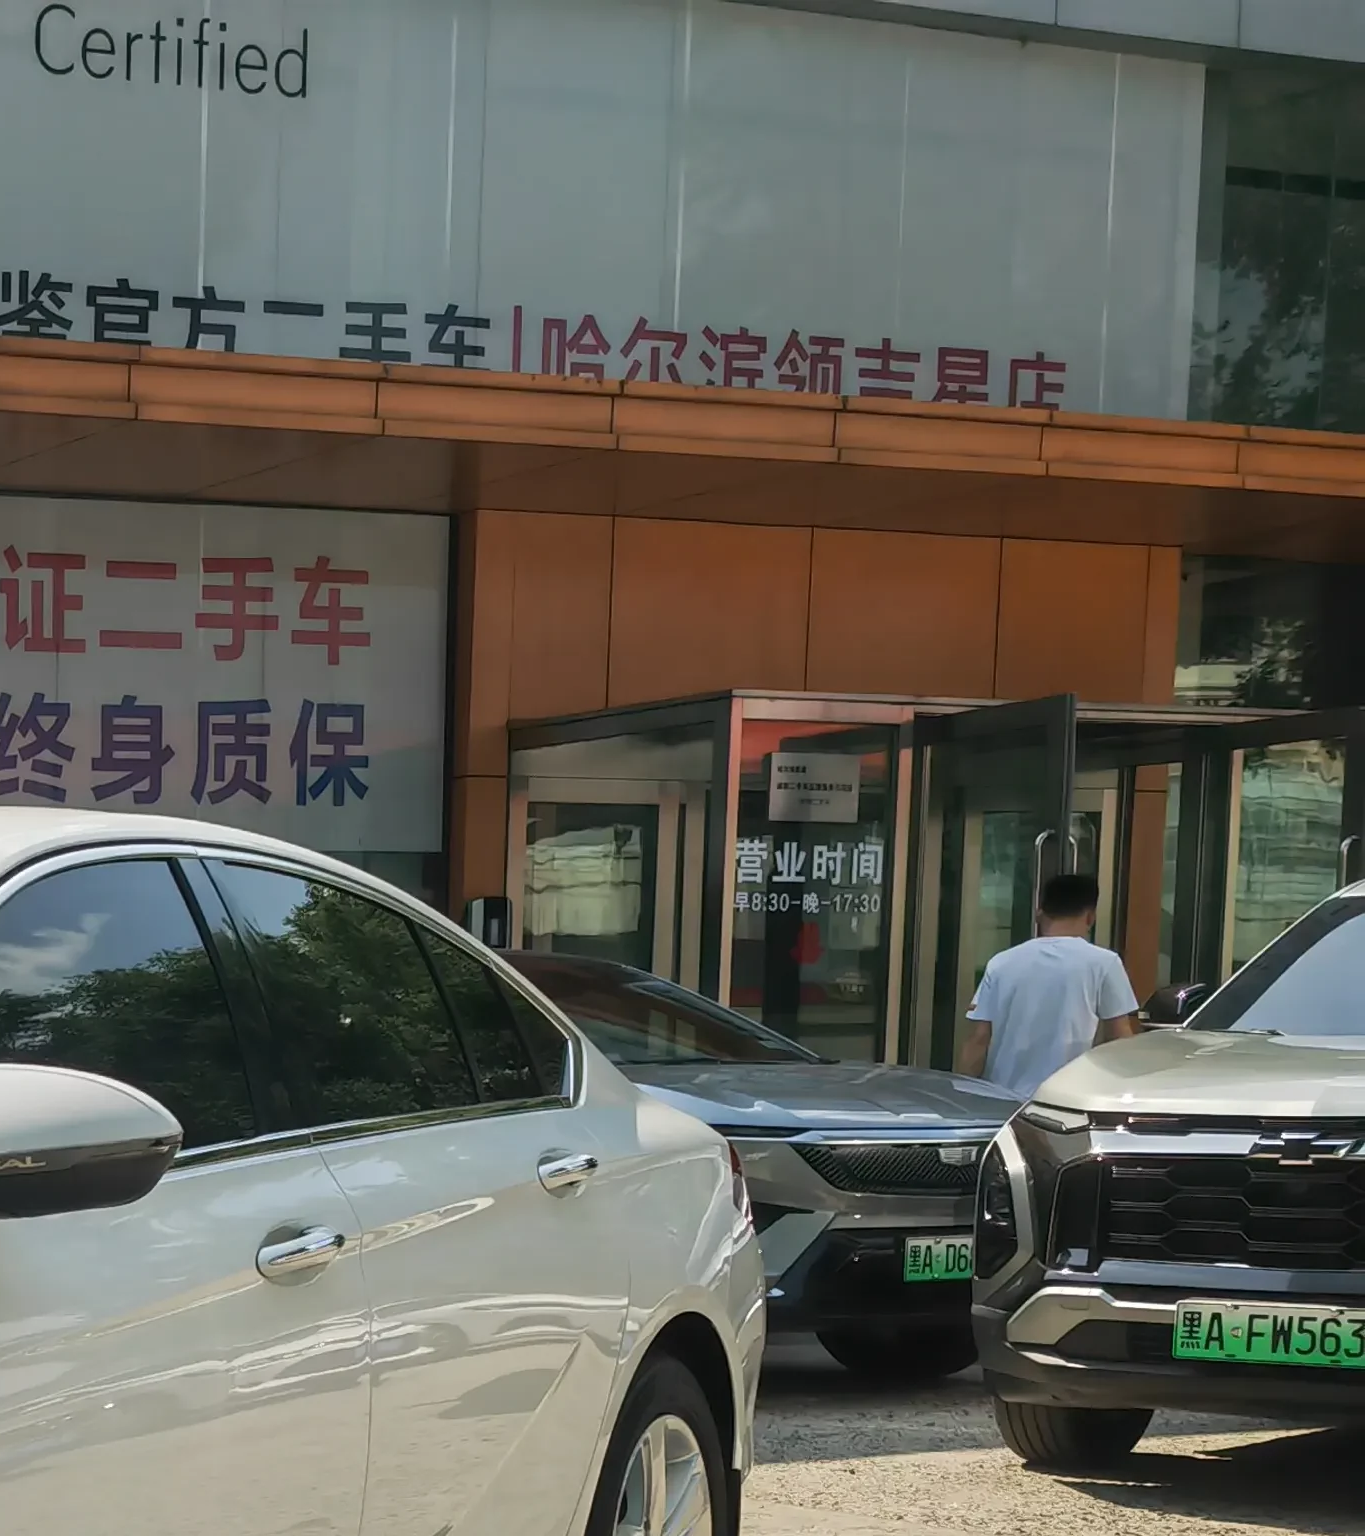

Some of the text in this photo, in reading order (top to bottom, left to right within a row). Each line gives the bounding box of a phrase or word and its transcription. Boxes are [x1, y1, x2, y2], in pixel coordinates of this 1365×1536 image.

[34, 3, 309, 99] Certified
[735, 838, 884, 885] 营业时间
